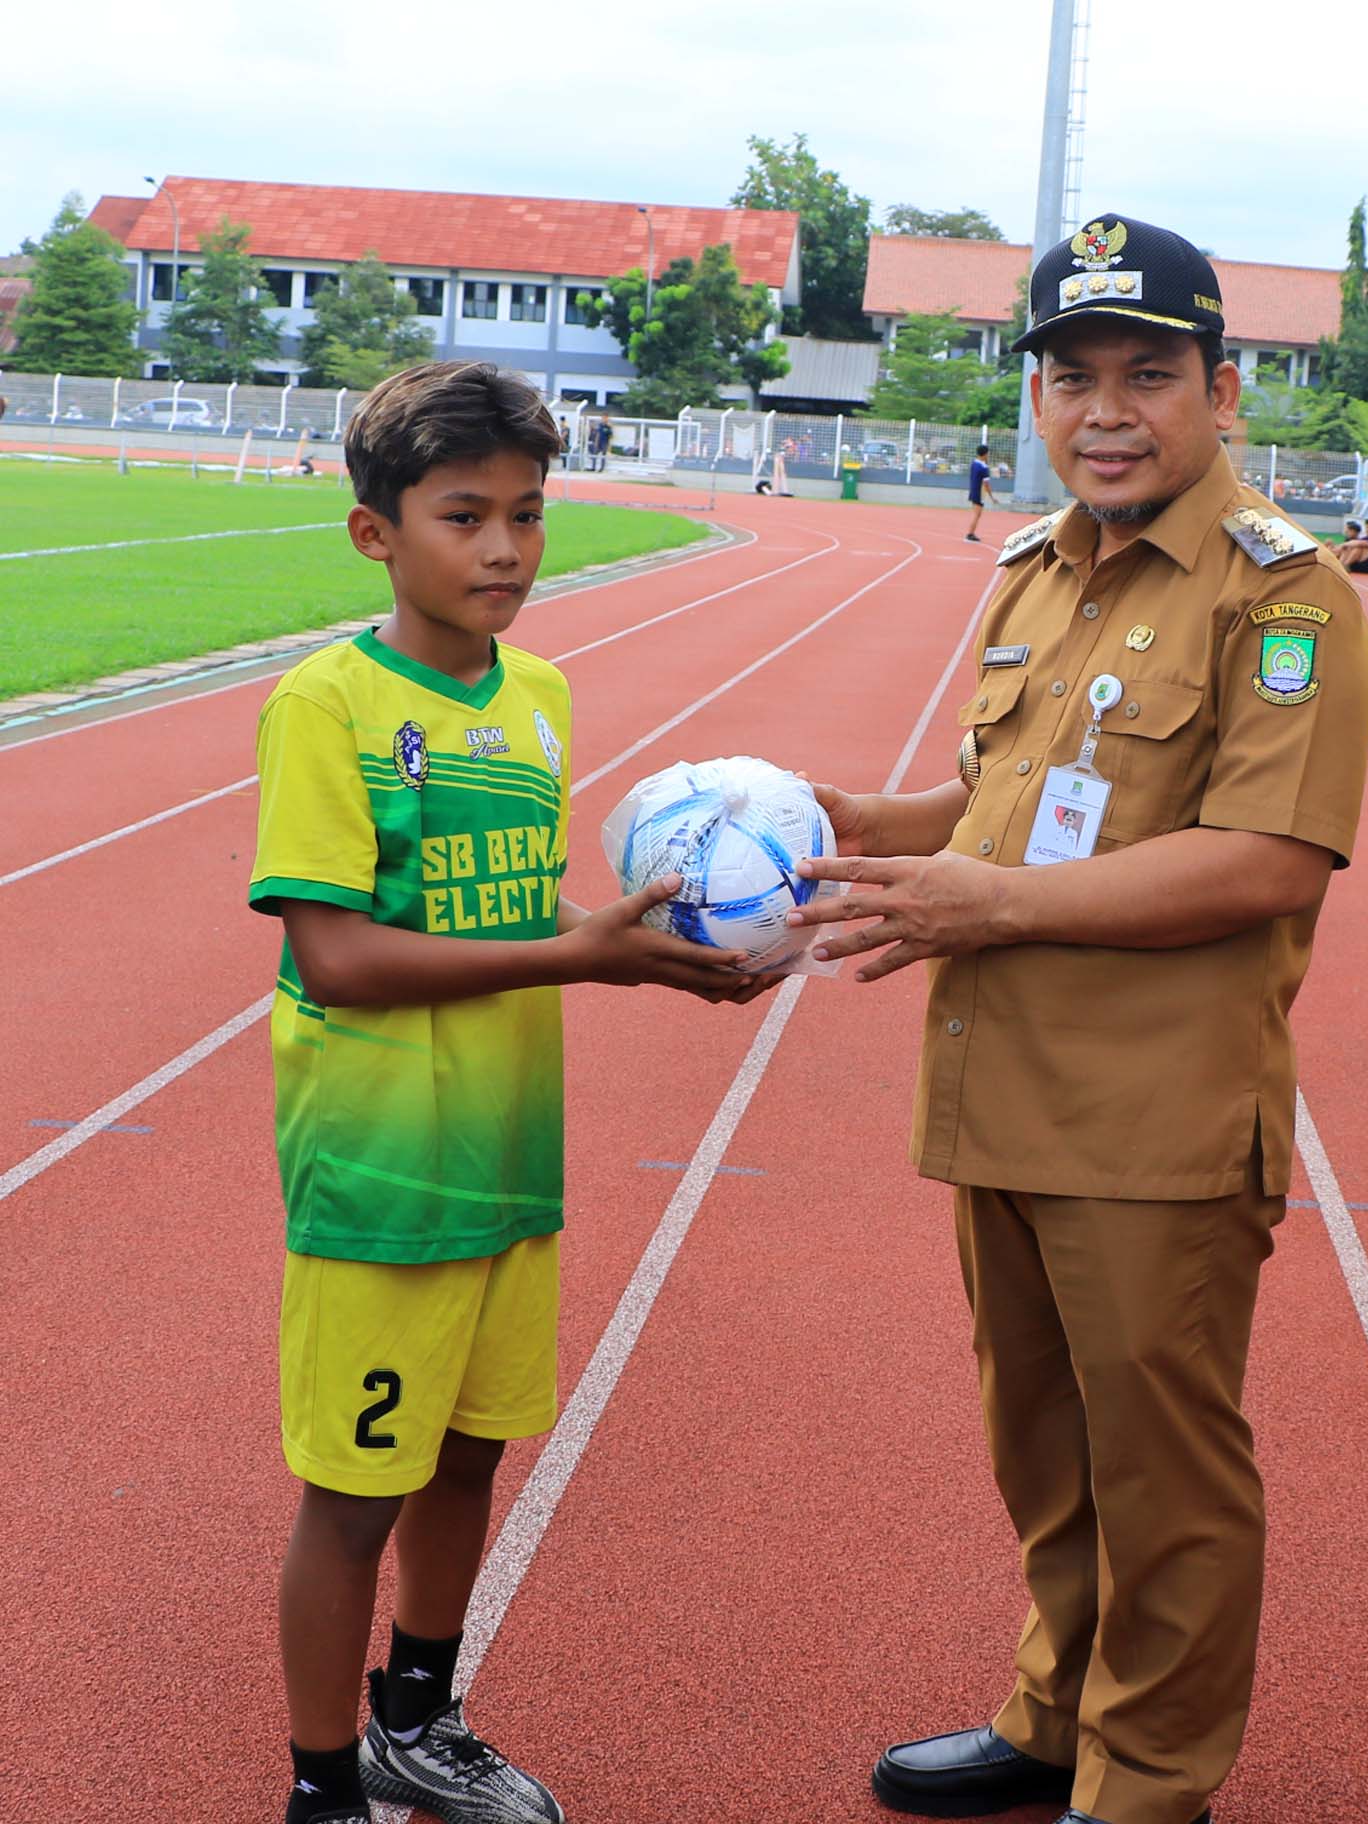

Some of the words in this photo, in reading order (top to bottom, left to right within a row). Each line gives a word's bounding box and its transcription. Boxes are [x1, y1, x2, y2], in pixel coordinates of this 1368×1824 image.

[1253, 607, 1275, 620] KOTA
[1279, 605, 1326, 620] TANGERANG
[422, 833, 477, 882] SB
[355, 1367, 402, 1449] 2
